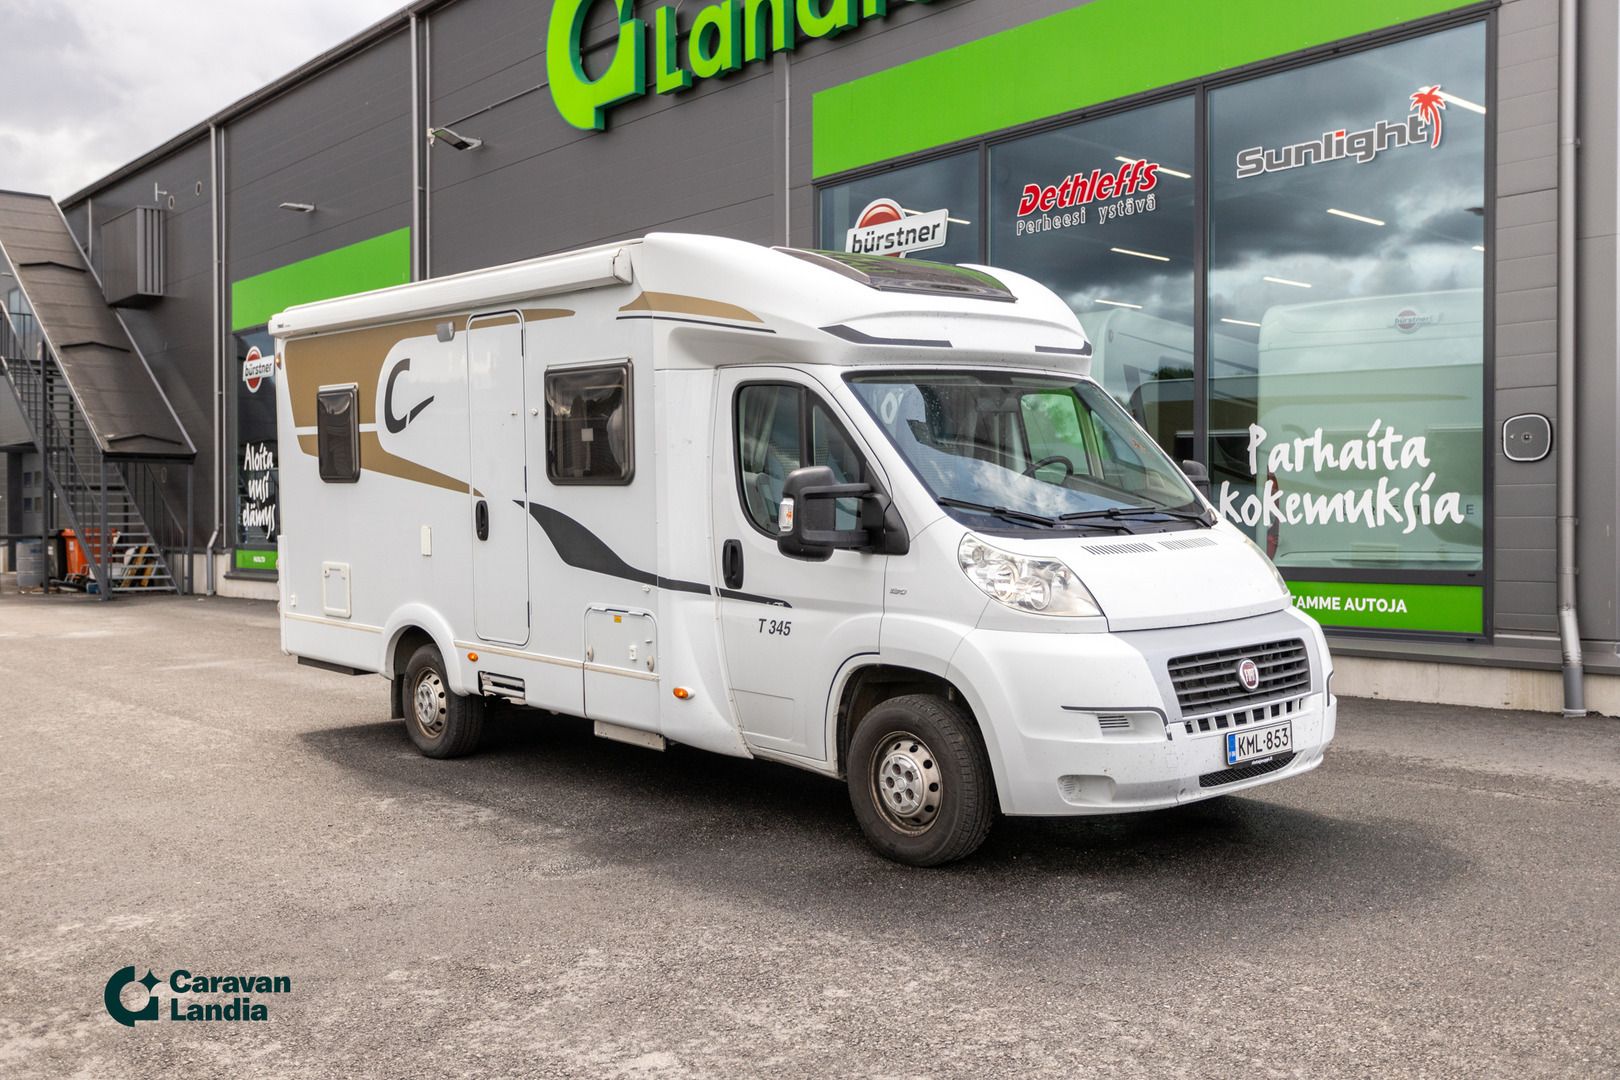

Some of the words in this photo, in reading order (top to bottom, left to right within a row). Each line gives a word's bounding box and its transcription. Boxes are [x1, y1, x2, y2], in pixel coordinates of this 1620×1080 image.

[1236, 113, 1427, 178] Sunlight
[1017, 159, 1159, 217] Dethleffs
[1016, 211, 1087, 236] Perheesi
[1098, 193, 1156, 223] ystävä
[851, 219, 941, 255] bürstner
[244, 361, 273, 378] bürstner
[243, 442, 274, 471] Aloita
[1247, 418, 1431, 475] Parhaita
[1344, 597, 1408, 613] AUTOJA
[758, 618, 767, 633] T
[768, 620, 792, 636] 345
[1238, 727, 1289, 757] KML-853
